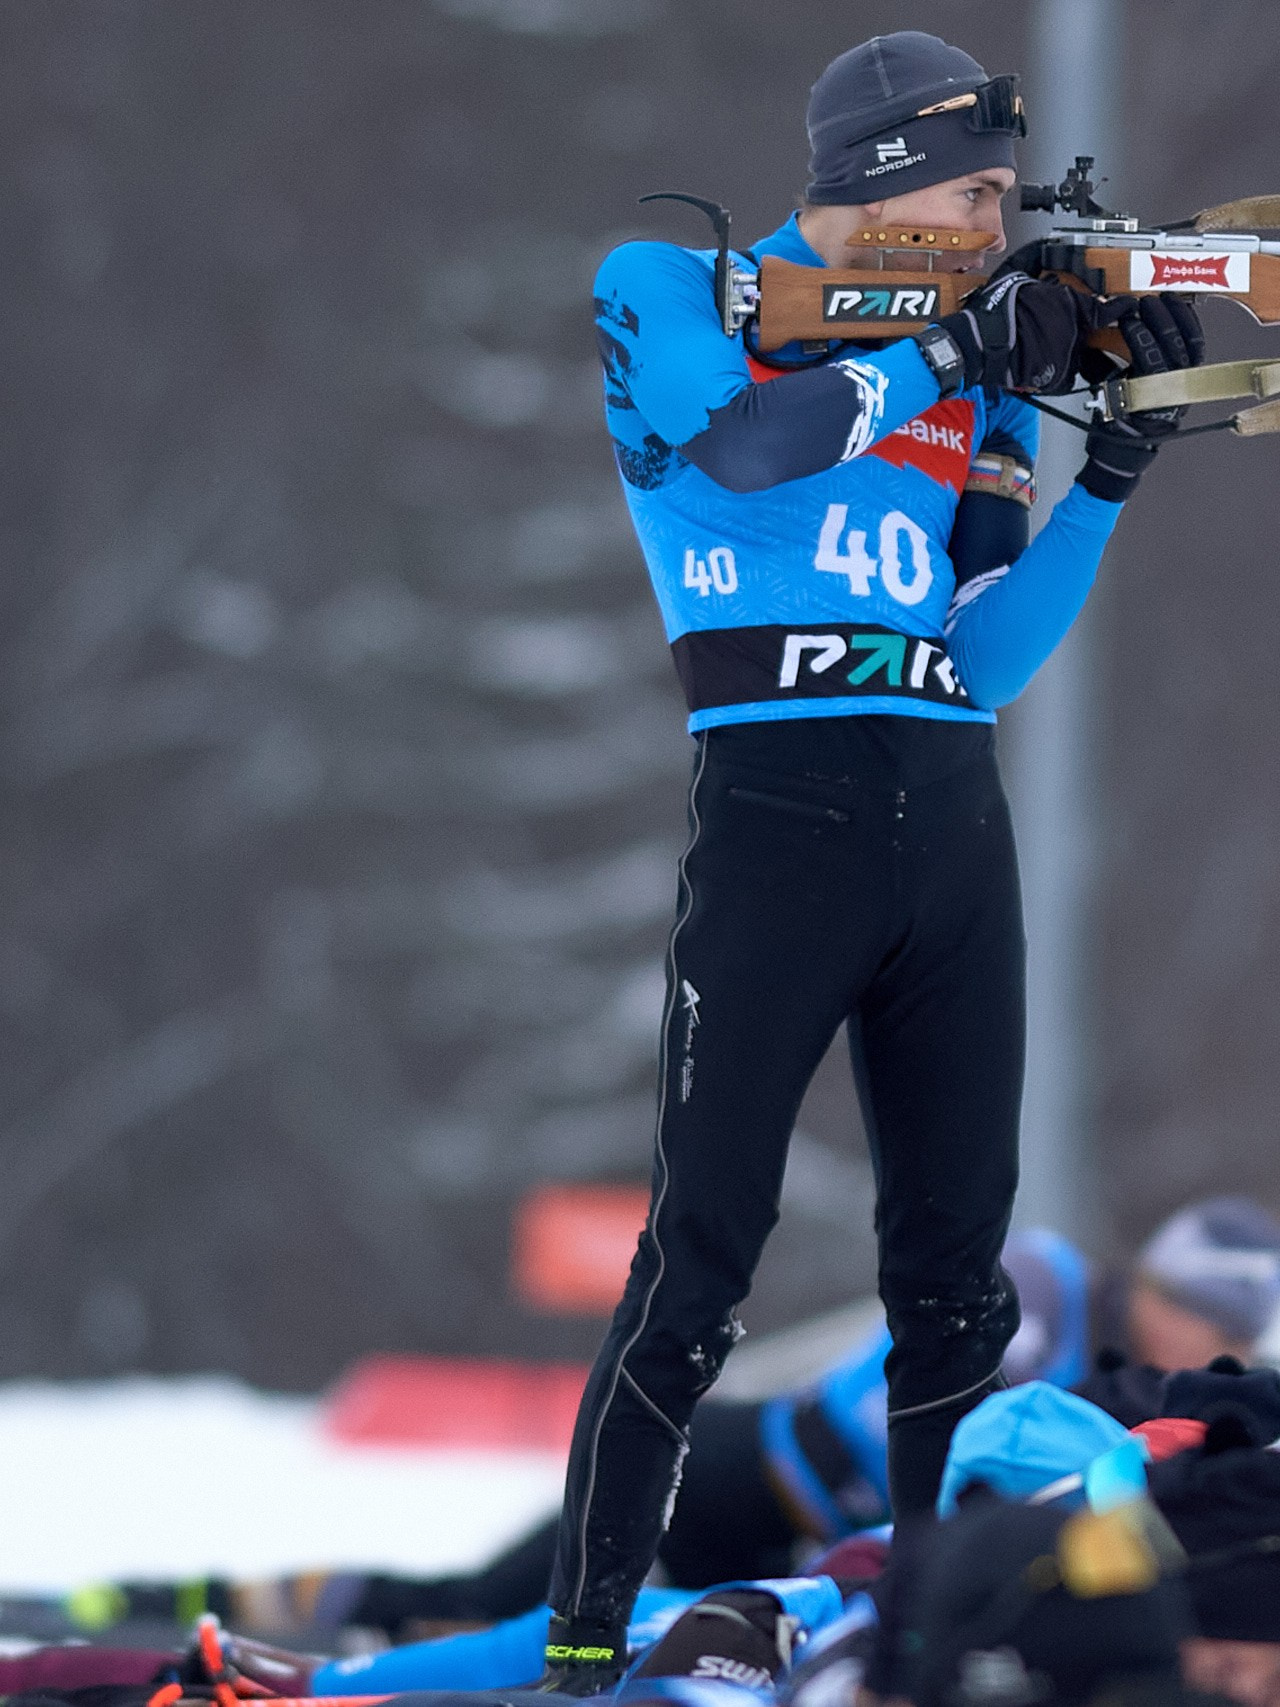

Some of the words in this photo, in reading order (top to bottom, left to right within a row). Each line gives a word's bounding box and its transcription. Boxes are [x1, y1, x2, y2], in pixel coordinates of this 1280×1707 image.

[865, 152, 927, 177] NORDSKI
[1162, 265, 1193, 277] Альфа
[1194, 266, 1217, 275] Банк
[827, 290, 937, 316] PARI
[684, 548, 738, 597] 40
[814, 503, 934, 606] 40
[779, 634, 967, 696] PAR
